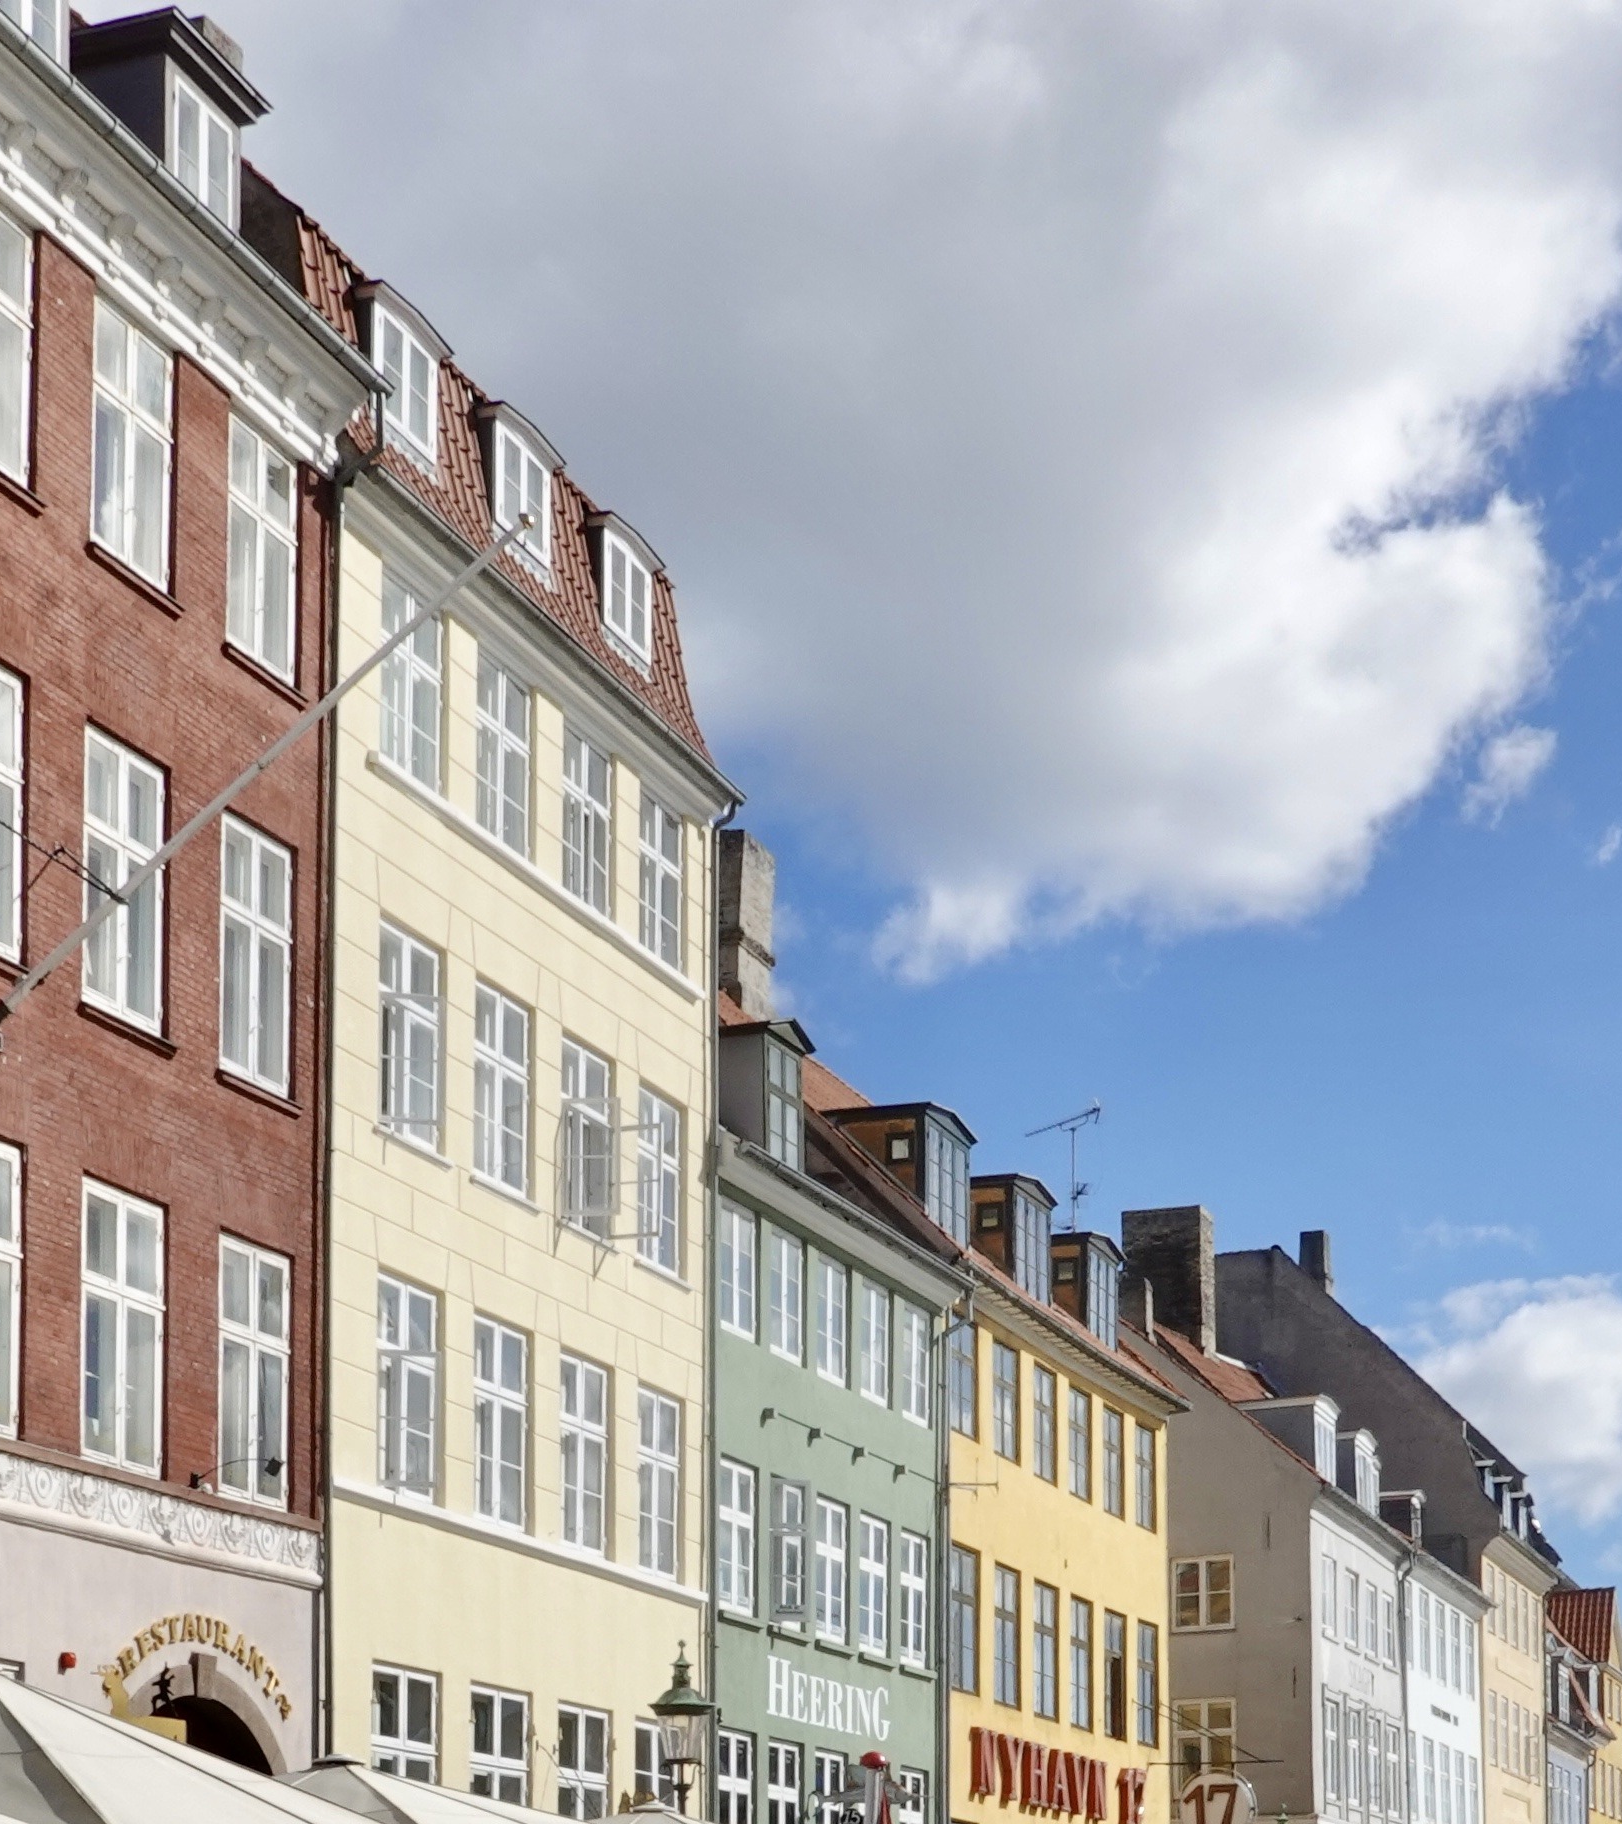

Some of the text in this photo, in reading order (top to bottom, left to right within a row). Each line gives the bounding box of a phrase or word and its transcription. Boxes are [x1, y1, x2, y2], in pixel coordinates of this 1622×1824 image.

[117, 1613, 279, 1698] RESTAURANT
[766, 1654, 890, 1741] HEERING
[969, 1726, 1108, 1821] NYHAVN
